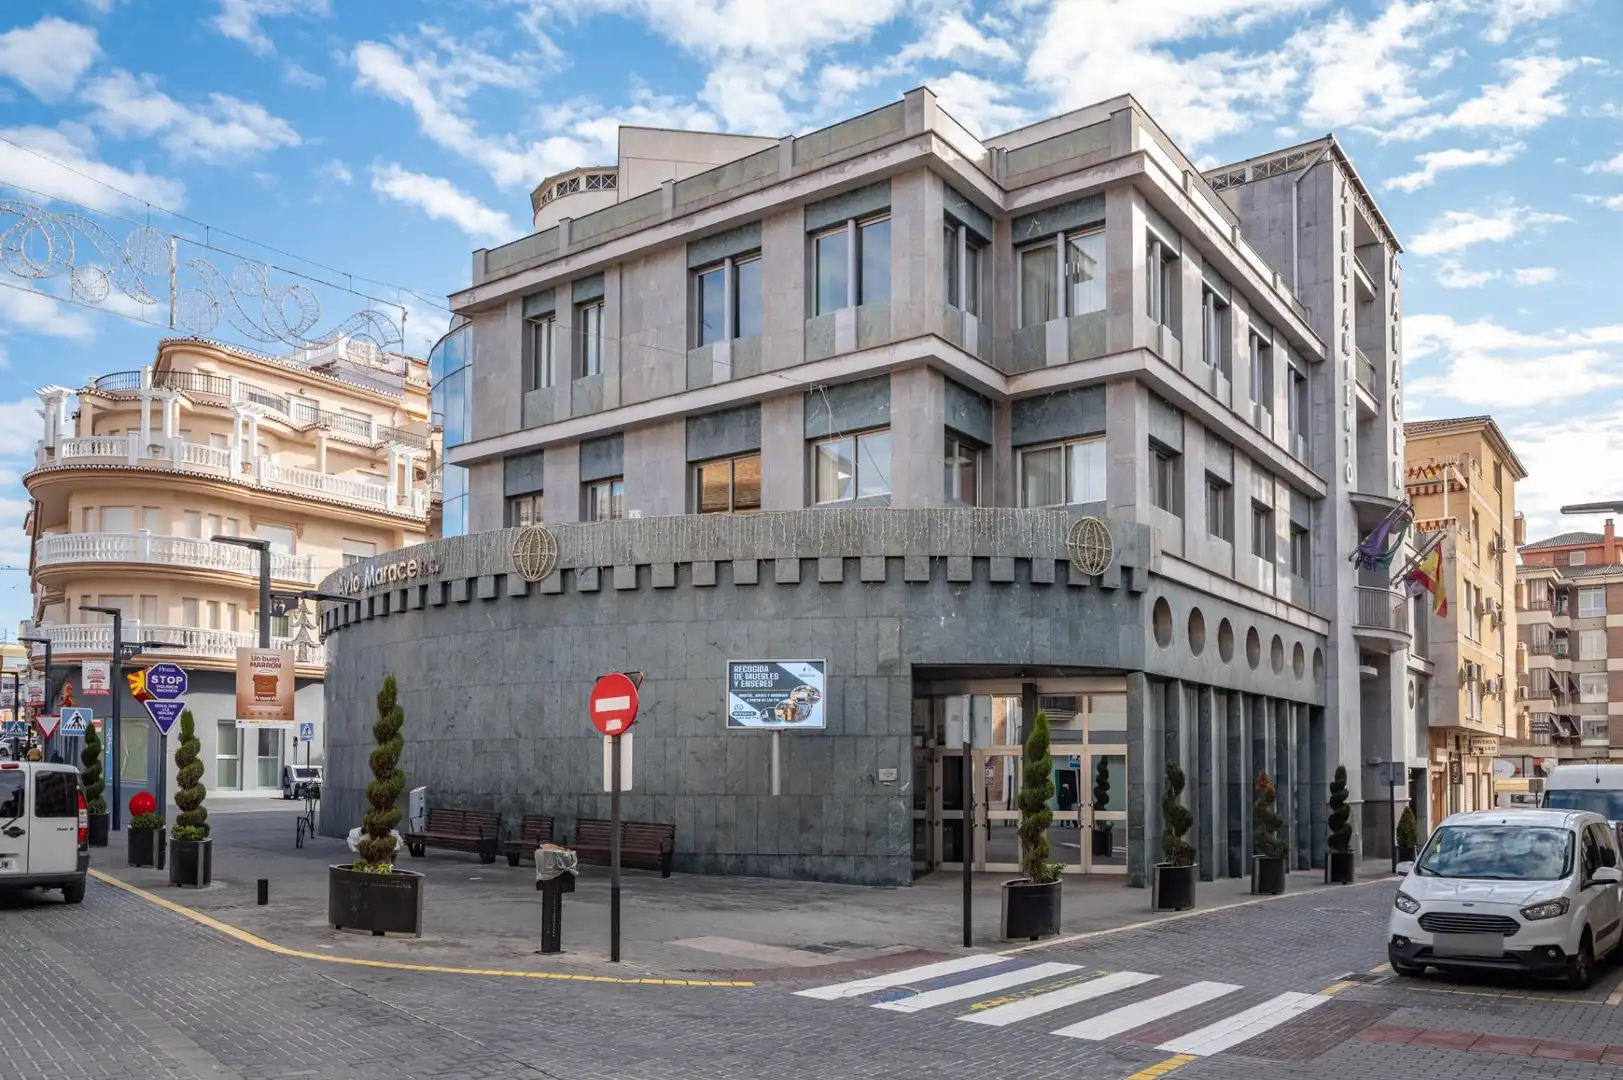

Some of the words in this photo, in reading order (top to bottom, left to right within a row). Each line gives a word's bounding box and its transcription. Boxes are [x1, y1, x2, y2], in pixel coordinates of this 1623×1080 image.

[1389, 256, 1401, 500] MARACEN
[734, 665, 769, 673] RECOGIDA
[151, 675, 183, 684] STOP
[734, 680, 739, 688] Y
[741, 680, 773, 688] ENSERES
